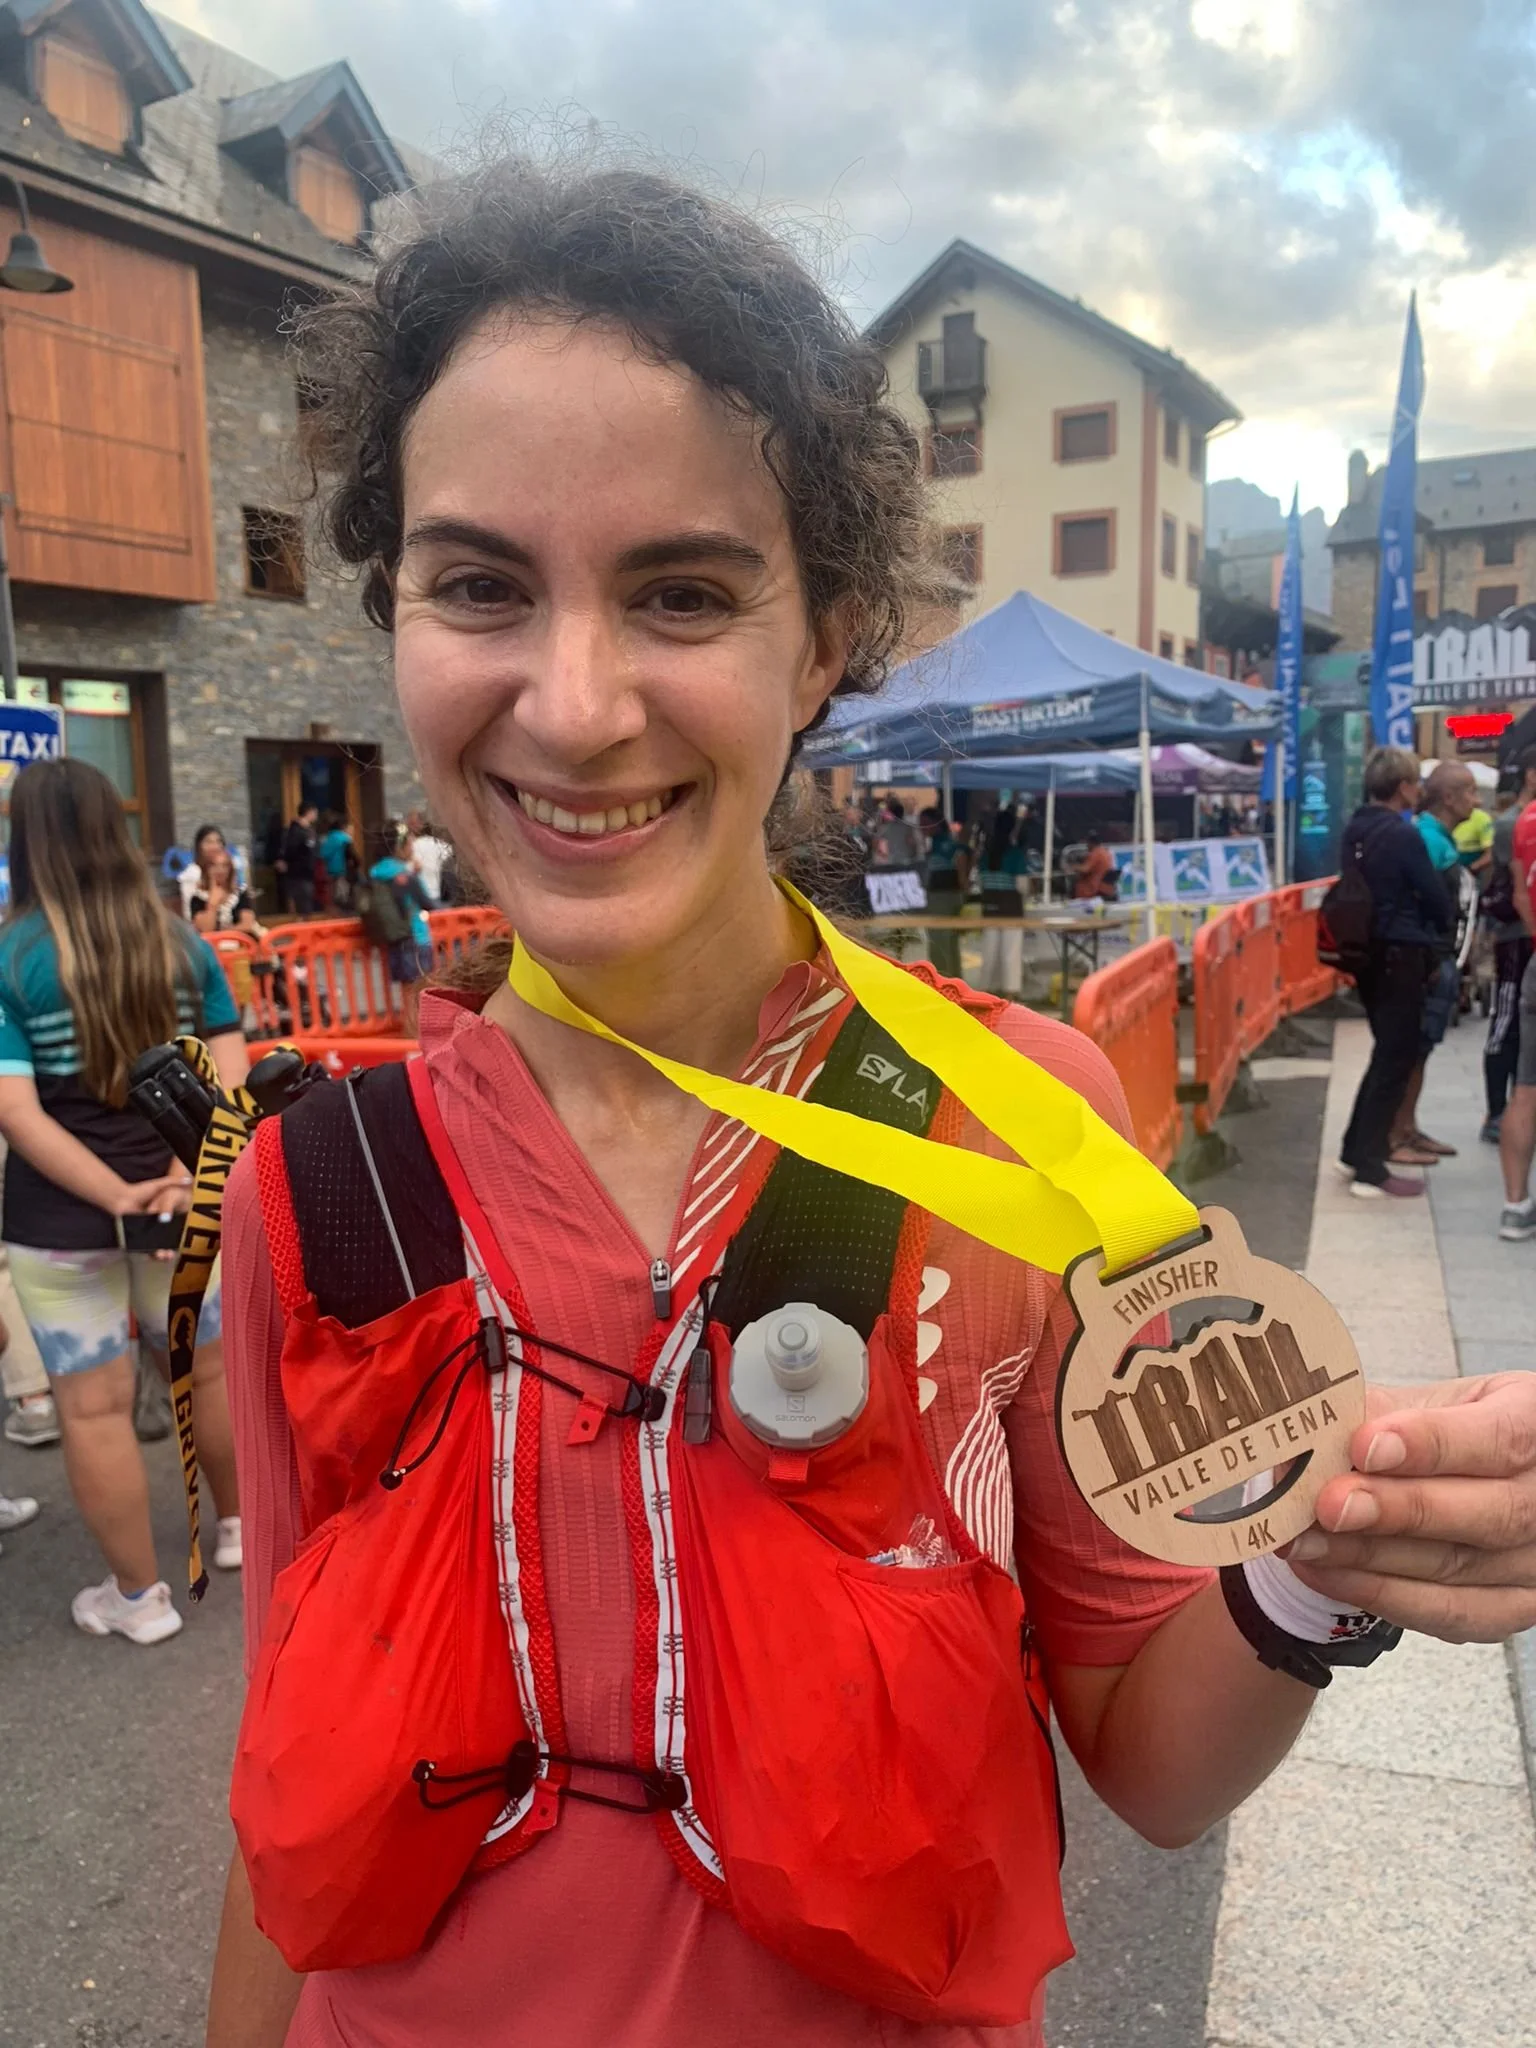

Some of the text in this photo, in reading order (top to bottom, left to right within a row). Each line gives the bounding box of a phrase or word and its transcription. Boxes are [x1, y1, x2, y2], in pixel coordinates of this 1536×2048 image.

[1413, 623, 1536, 685] TRAIL
[1467, 681, 1488, 699] DE
[0, 730, 59, 761] TAXI
[1112, 1260, 1219, 1325] FINISHER
[1073, 1318, 1333, 1486] TRAIL
[1123, 1399, 1339, 1516] VALLE DE TENA
